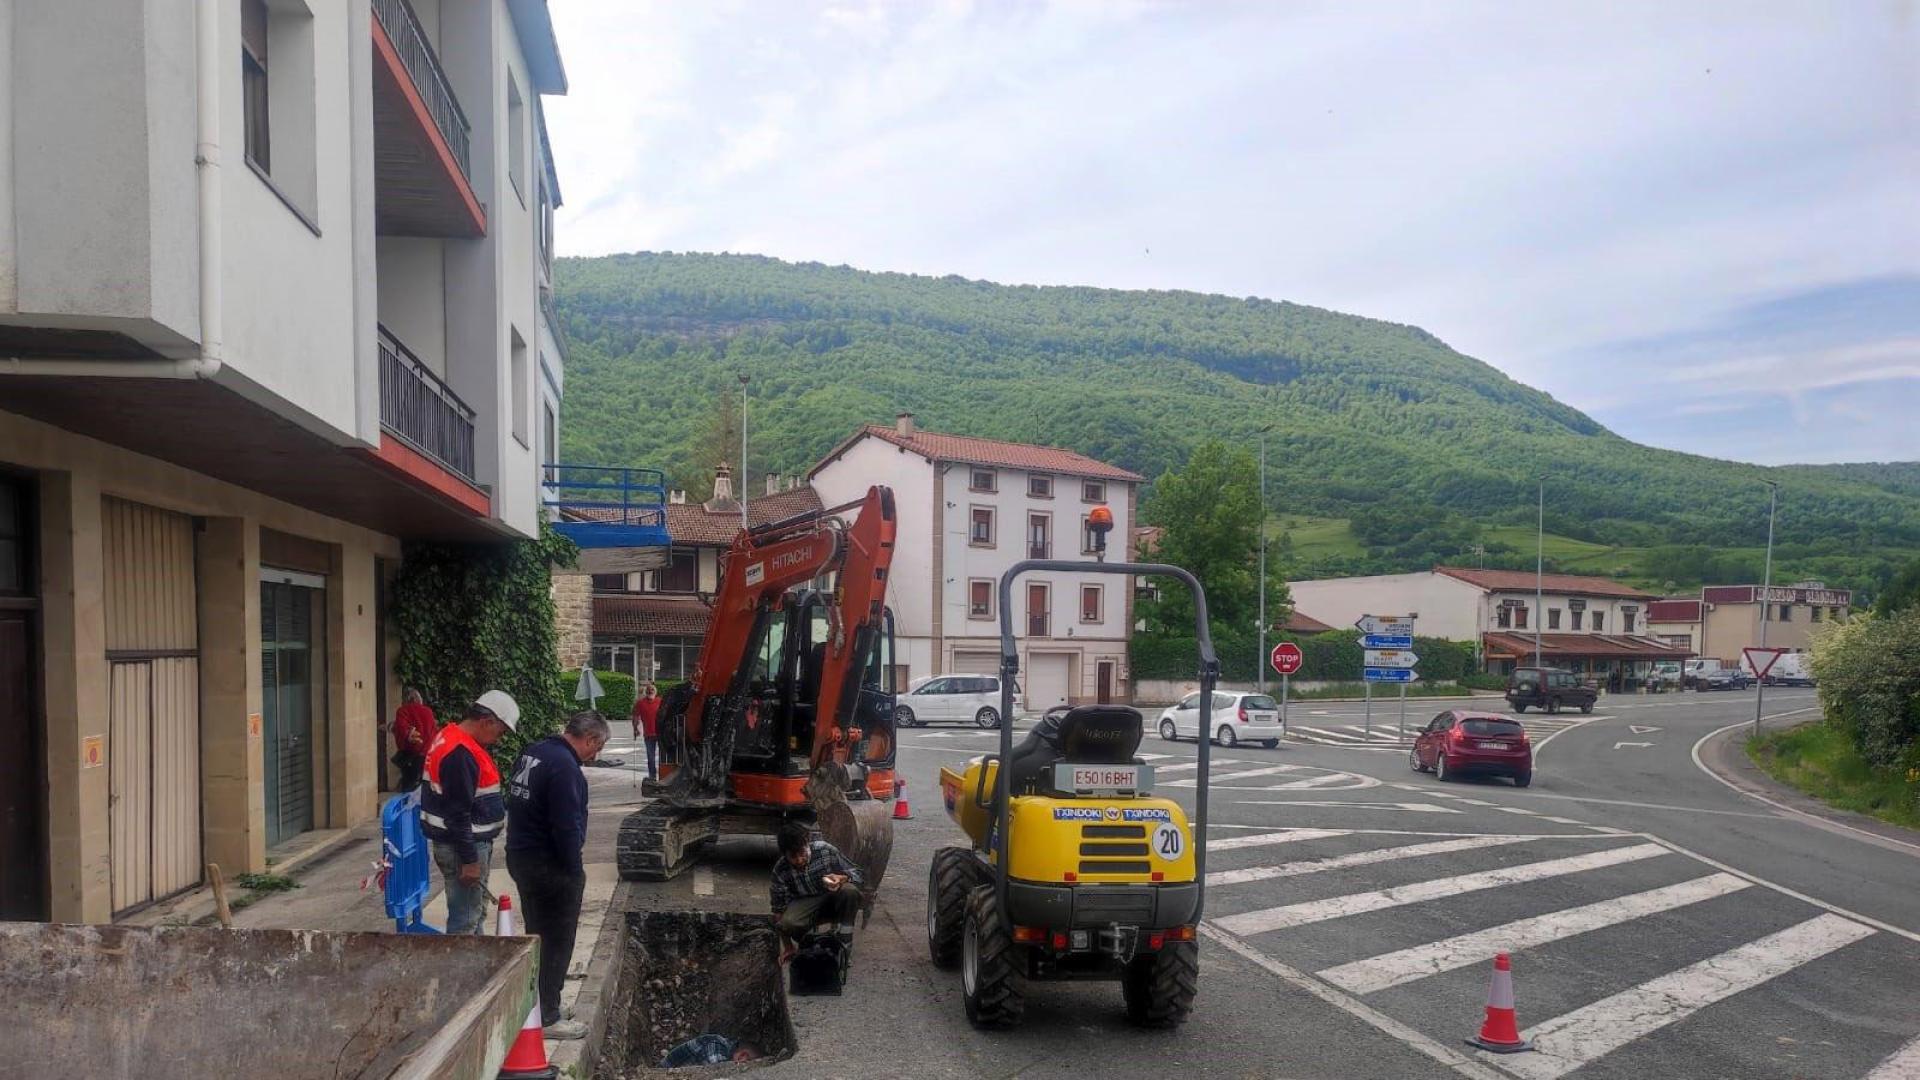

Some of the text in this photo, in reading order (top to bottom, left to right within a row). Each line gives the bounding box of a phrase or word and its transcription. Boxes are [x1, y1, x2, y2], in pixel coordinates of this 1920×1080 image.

[772, 546, 812, 569] HITACHI
[1275, 654, 1299, 663] STOP
[1075, 771, 1135, 785] E 5016 BHT
[1055, 808, 1102, 818] TXINDOKI
[1160, 829, 1180, 854] 20
